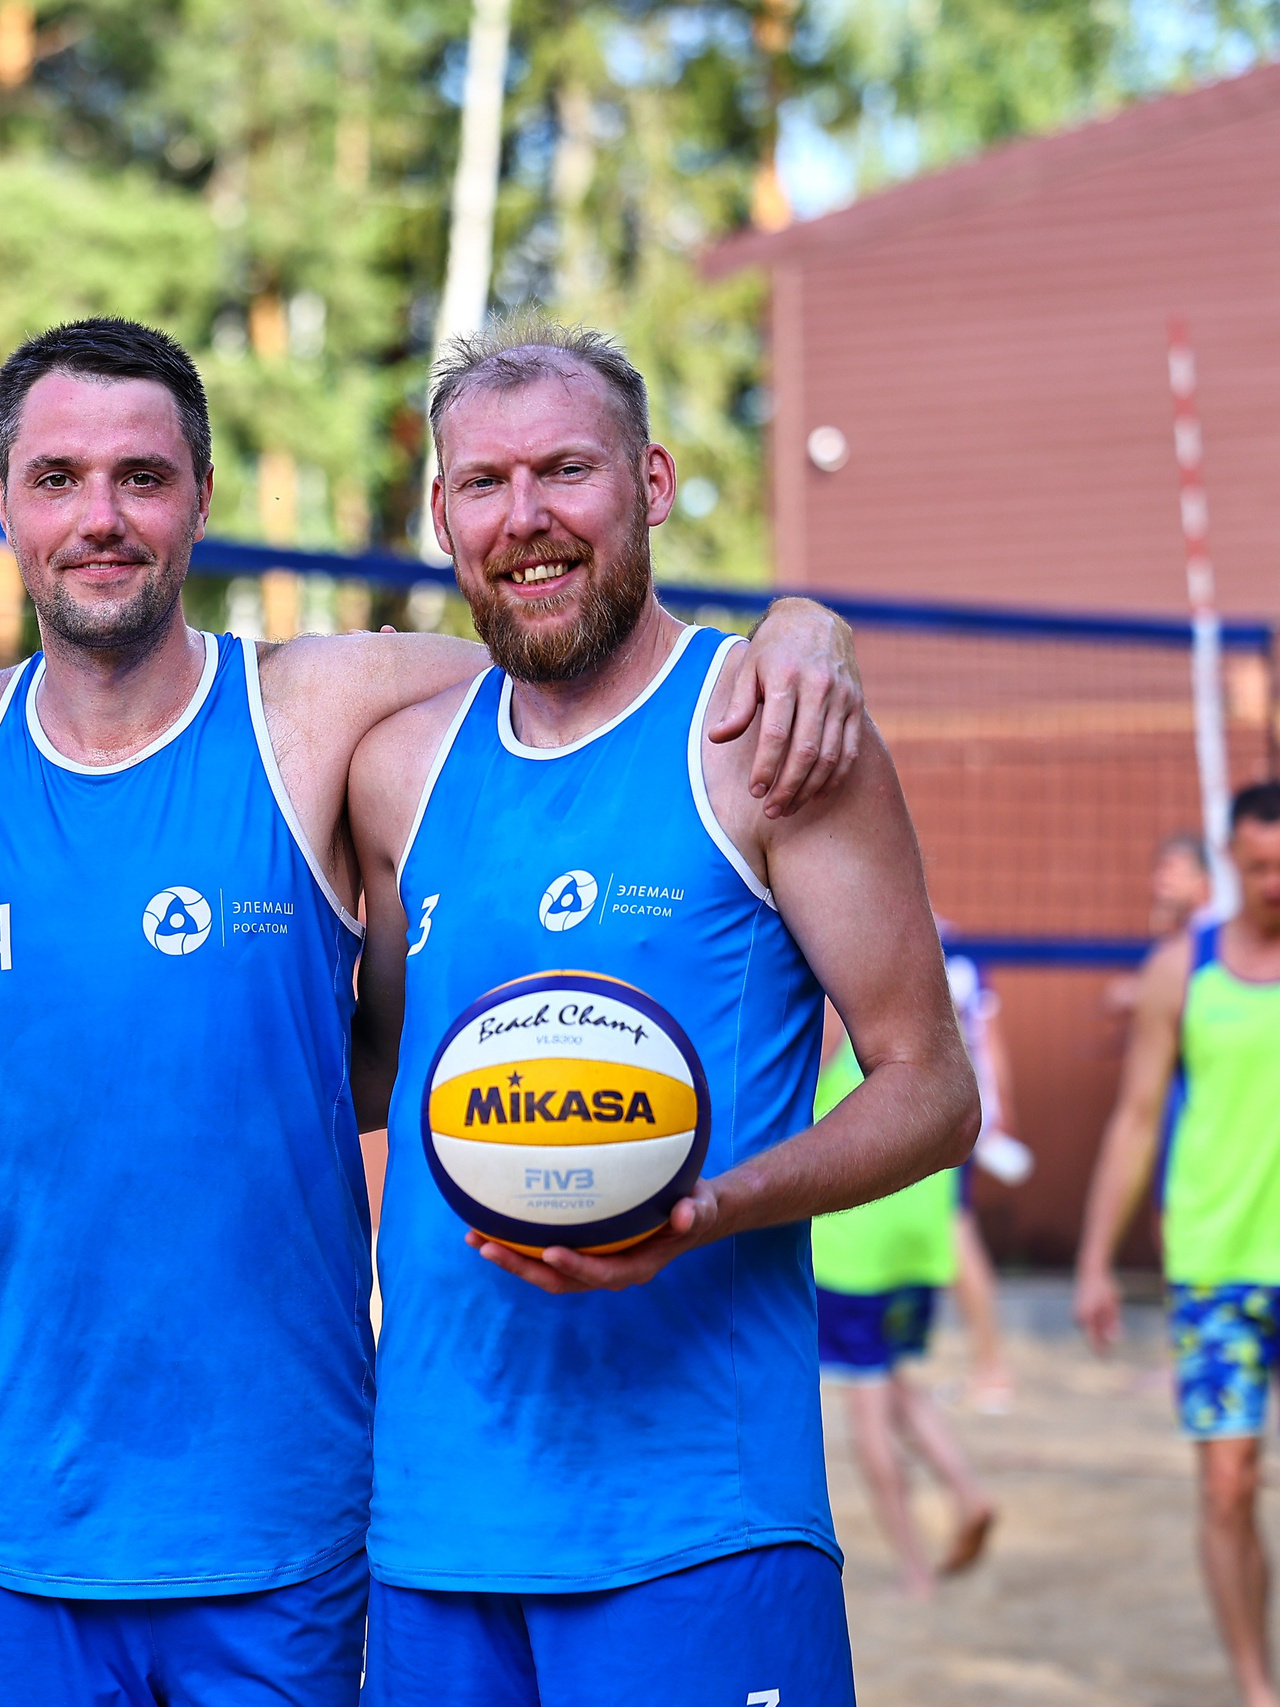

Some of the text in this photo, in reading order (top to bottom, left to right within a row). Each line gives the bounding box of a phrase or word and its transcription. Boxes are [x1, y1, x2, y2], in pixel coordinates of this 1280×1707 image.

[616, 885, 684, 900] ЭЛЕМАШ
[232, 901, 294, 915] ЭЛЕМАШ
[612, 904, 672, 917] РОСАТОМ
[233, 923, 288, 934] РОСАТОМ
[407, 893, 440, 957] 3
[478, 1004, 649, 1045] Beach Champ
[525, 1168, 595, 1191] FIVB
[527, 1199, 595, 1210] APPROVED
